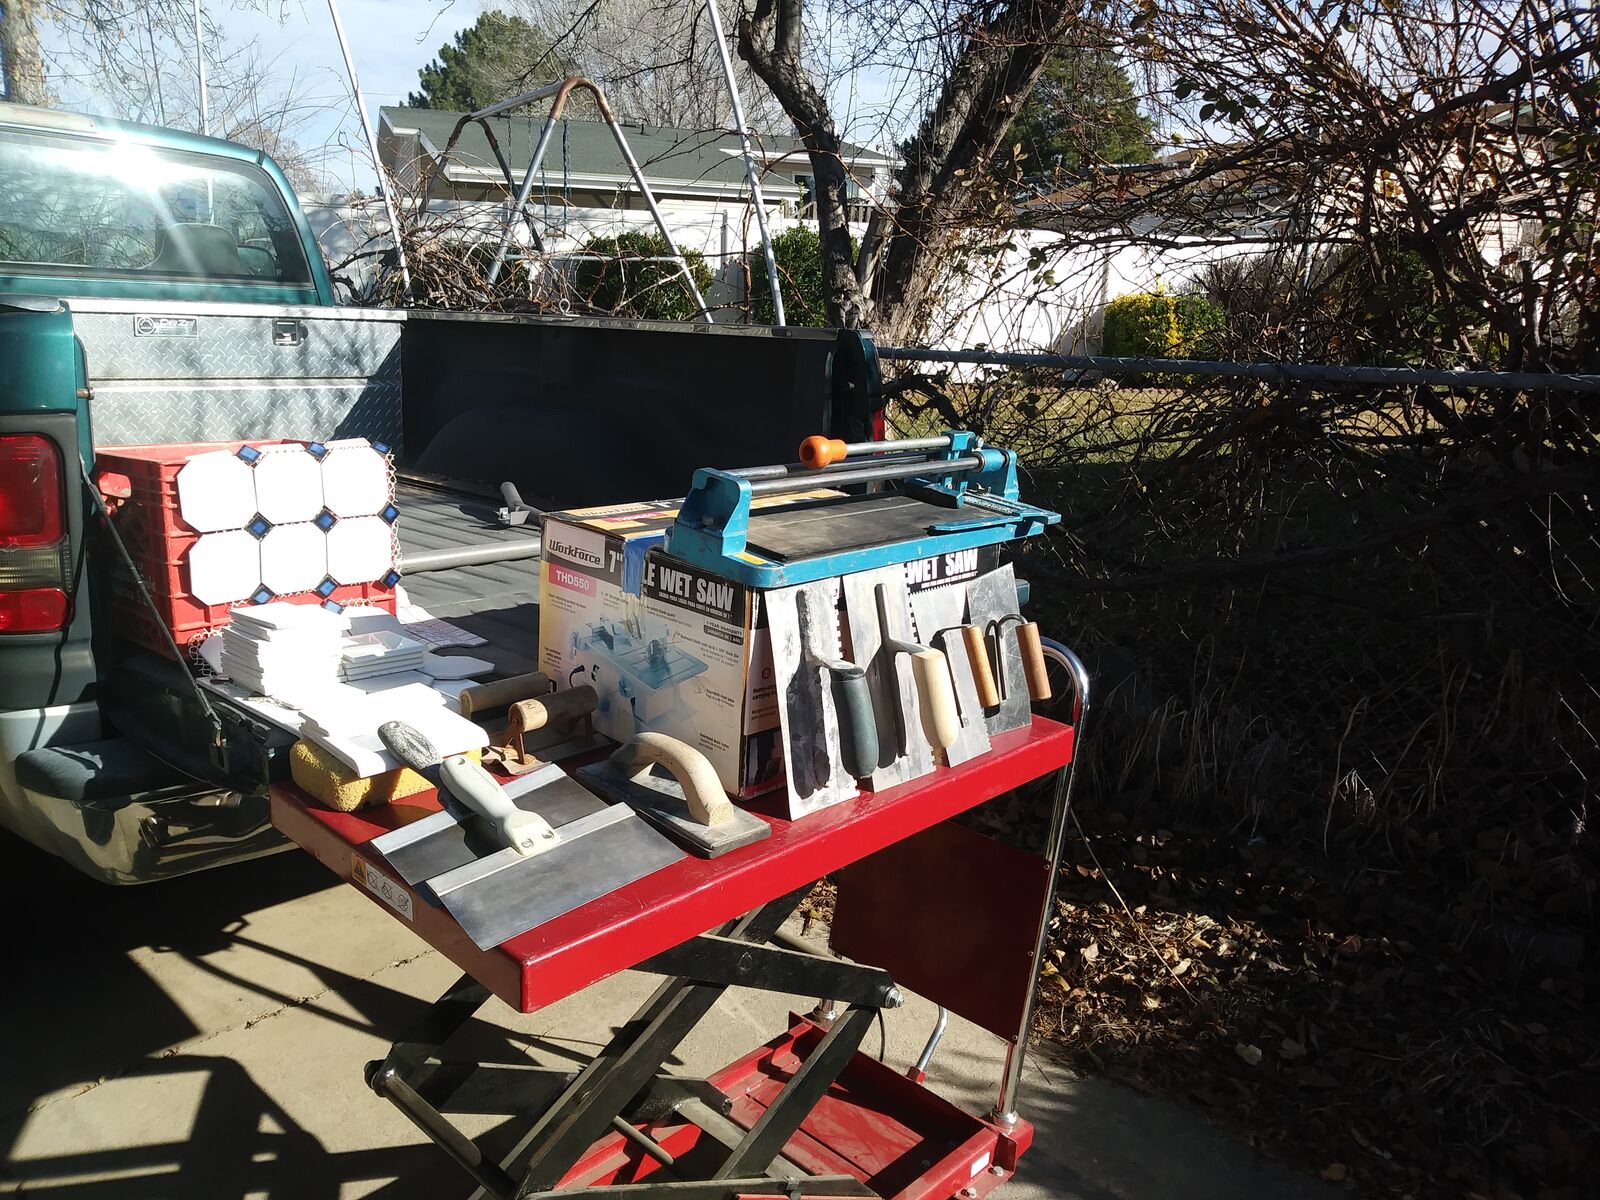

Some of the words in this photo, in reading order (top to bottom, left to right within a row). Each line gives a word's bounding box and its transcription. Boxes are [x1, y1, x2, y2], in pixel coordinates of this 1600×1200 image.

[549, 539, 601, 565] WorkForce
[907, 556, 939, 585] WET
[945, 547, 979, 577] SAW
[555, 570, 590, 591] THD550
[608, 549, 623, 573] 7"
[660, 566, 692, 598] WET
[696, 577, 734, 612] SAW
